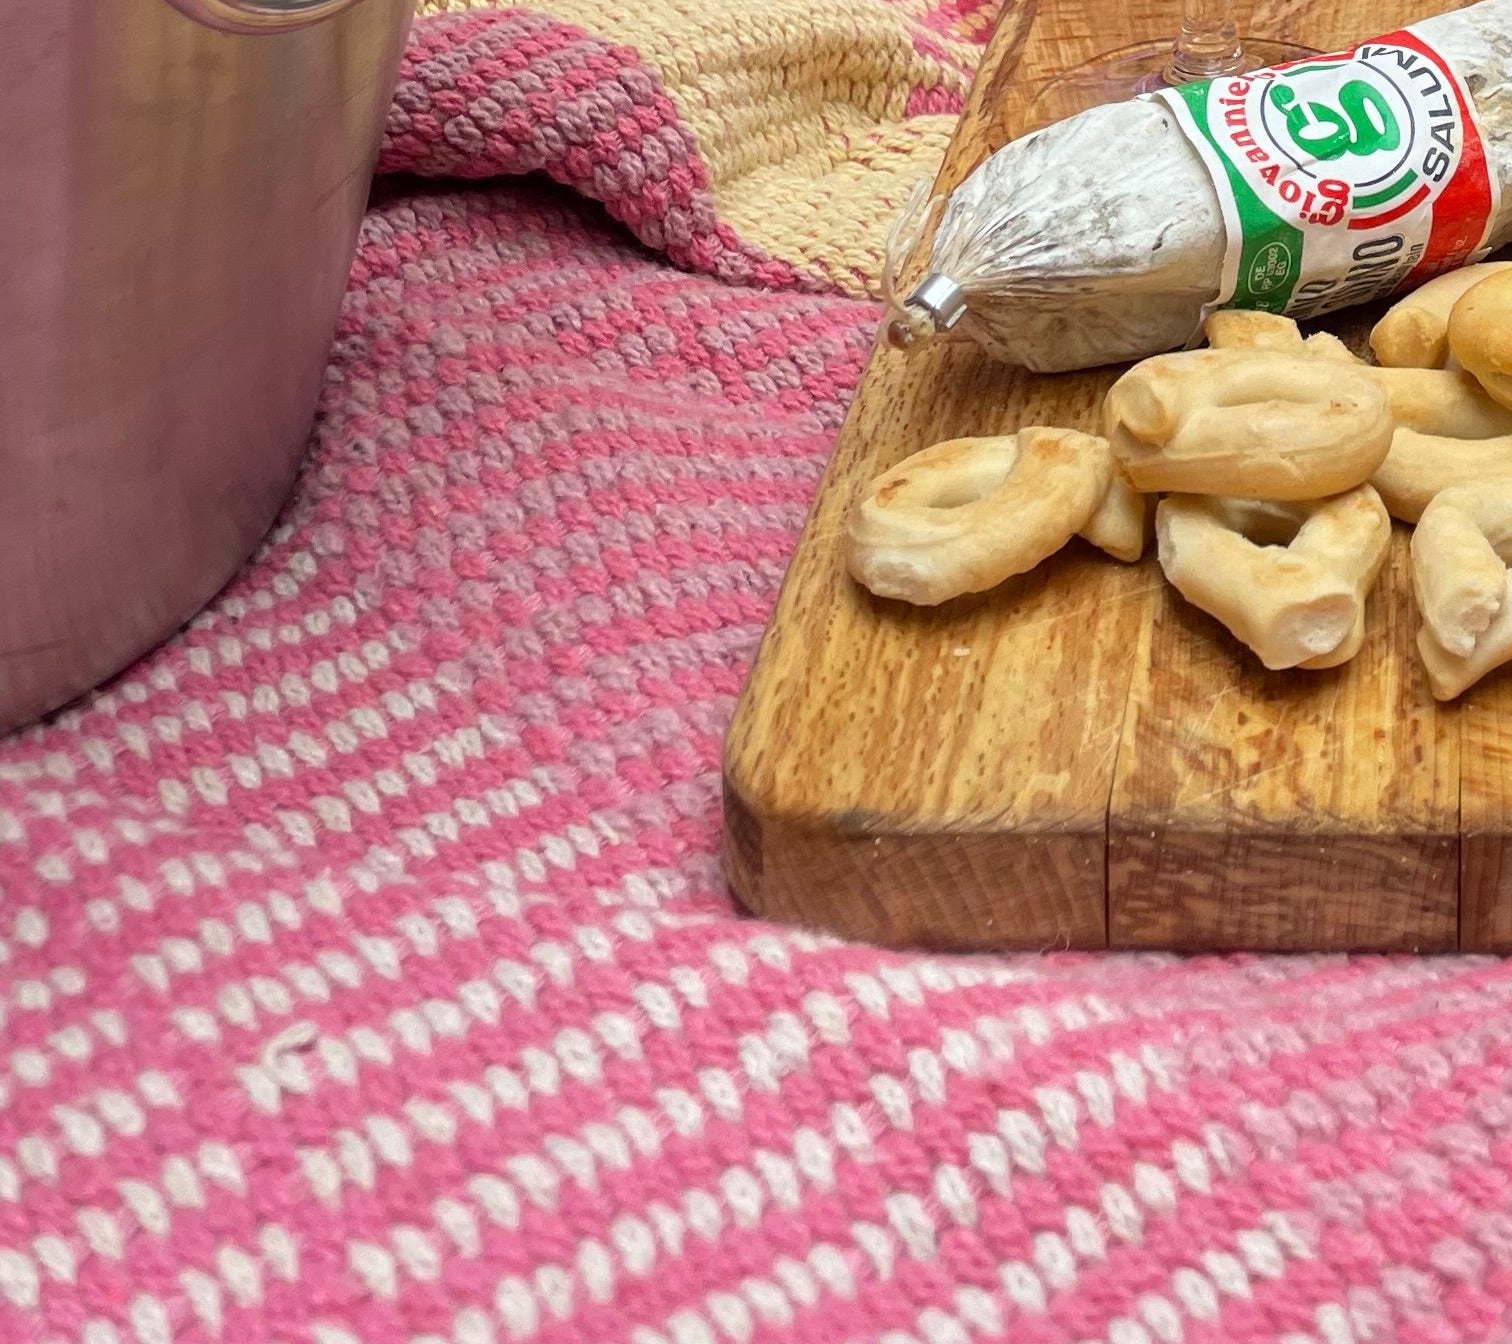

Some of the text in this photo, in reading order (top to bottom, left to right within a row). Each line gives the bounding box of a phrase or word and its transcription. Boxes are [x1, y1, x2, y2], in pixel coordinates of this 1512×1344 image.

[1361, 46, 1456, 183] SALUMI
[1254, 265, 1267, 282] DE
[1275, 260, 1287, 276] EG
